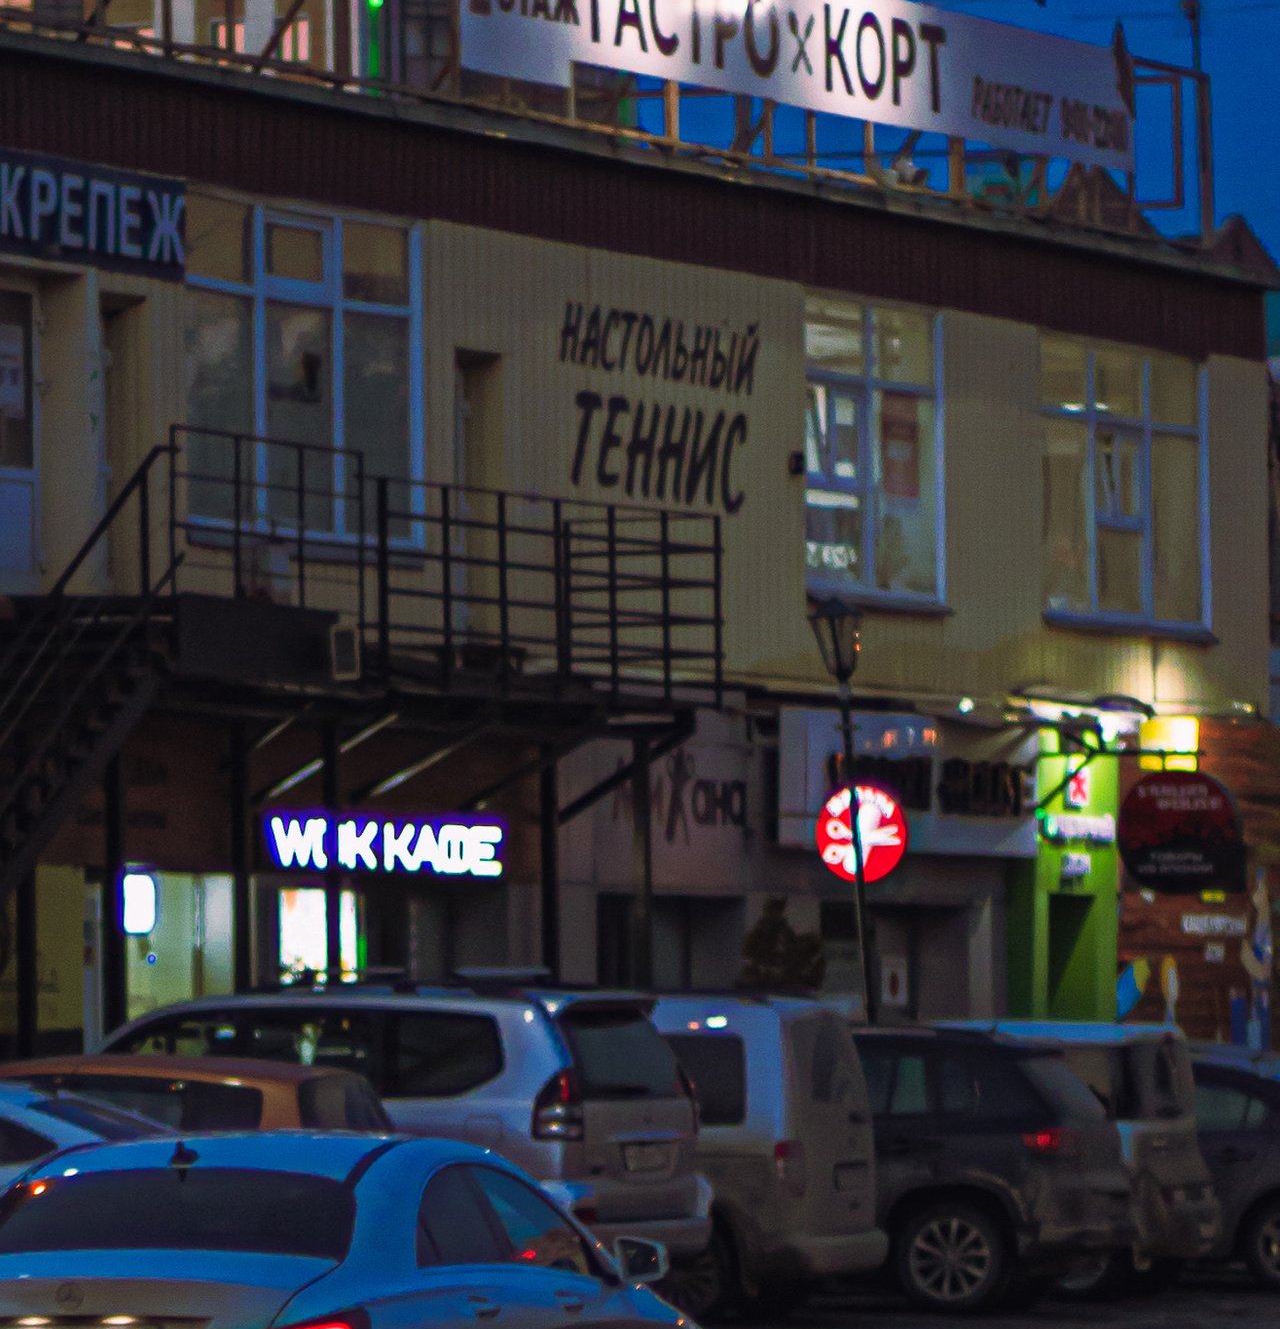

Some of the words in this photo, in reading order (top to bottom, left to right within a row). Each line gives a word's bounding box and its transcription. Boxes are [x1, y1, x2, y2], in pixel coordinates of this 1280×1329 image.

[824, 3, 947, 114] КОРТ
[0, 162, 186, 266] КРЕПЕЖ
[559, 300, 760, 397] НАСТОЛЬНЫЙ
[570, 389, 748, 514] ТЕННИС
[383, 821, 503, 877] КАФЕ
